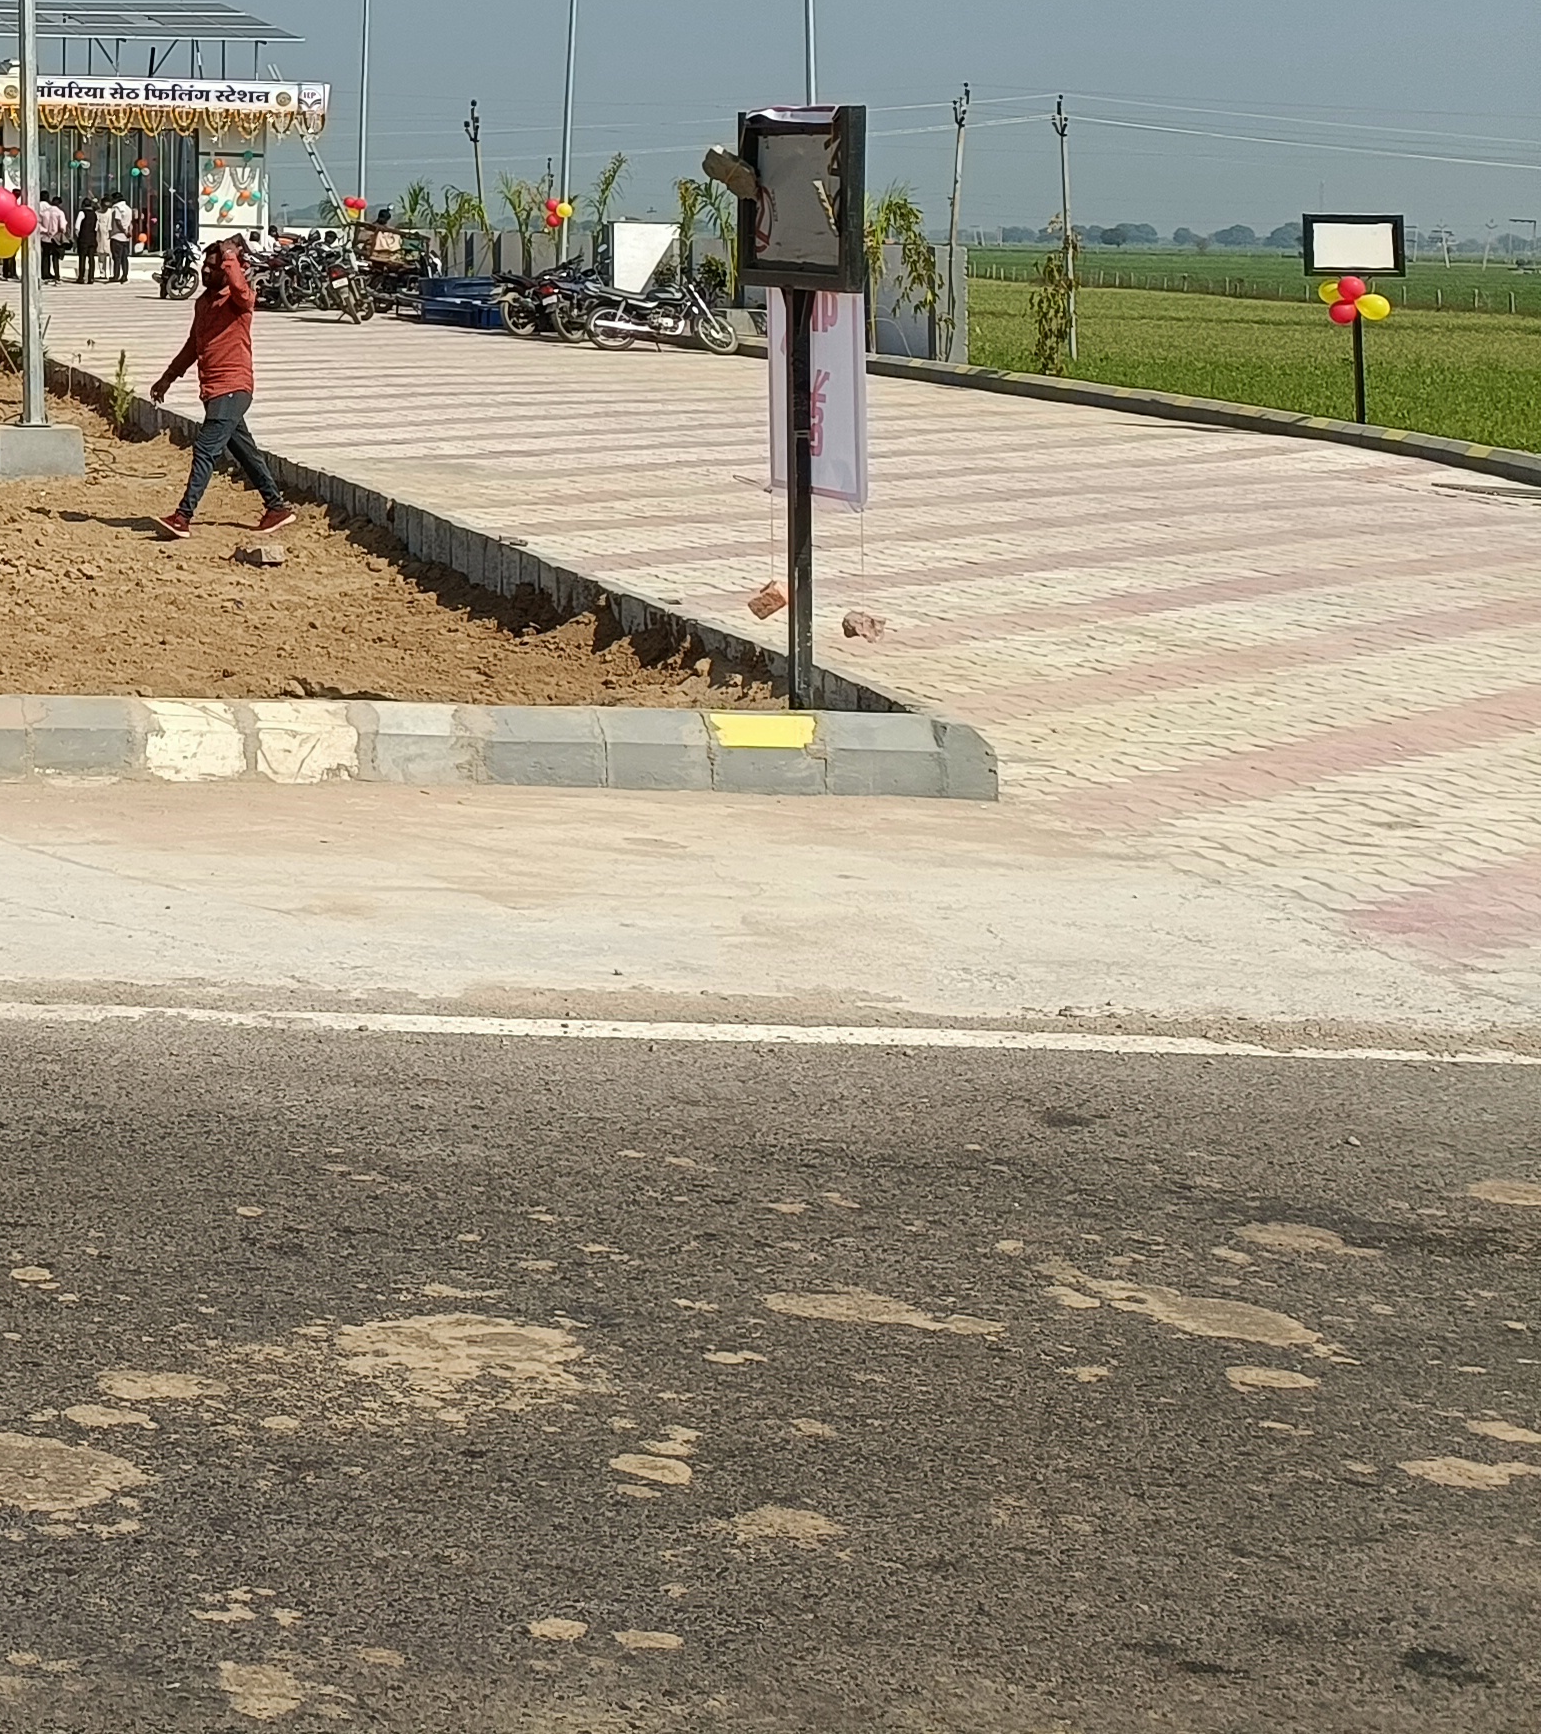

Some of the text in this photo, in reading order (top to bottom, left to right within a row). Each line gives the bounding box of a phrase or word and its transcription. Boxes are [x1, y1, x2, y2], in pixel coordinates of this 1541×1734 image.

[109, 82, 140, 100] सेठ
[144, 83, 211, 102] फिलिंग
[215, 85, 270, 103] स्टेशन
